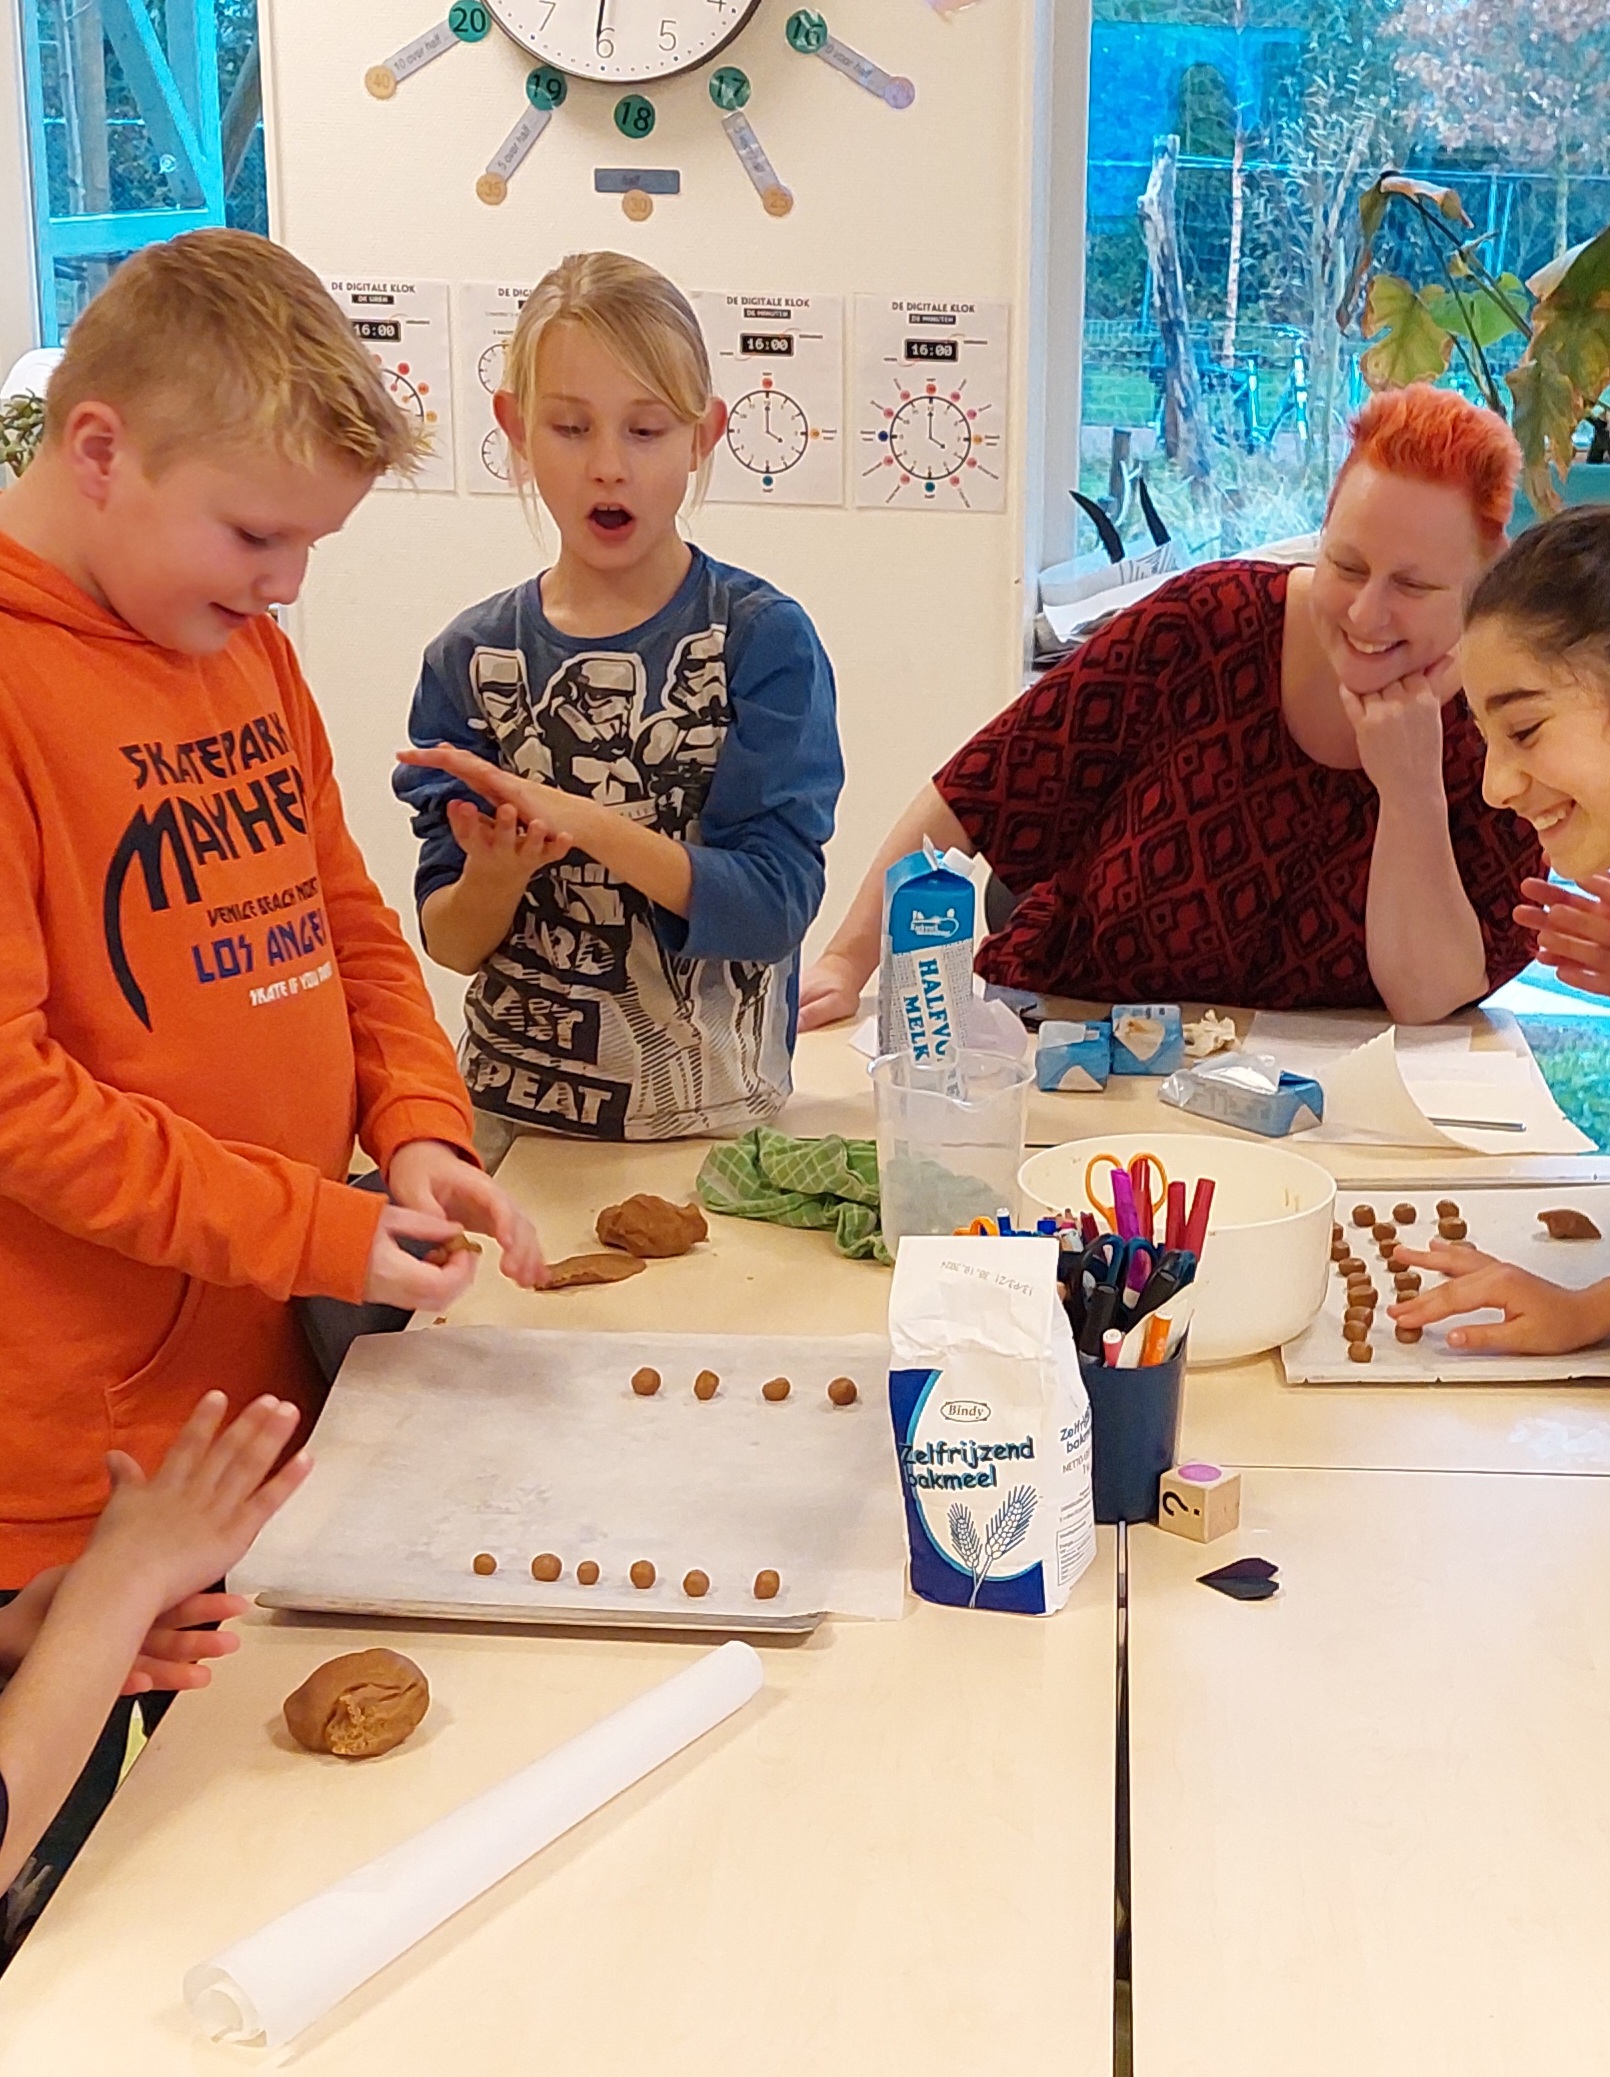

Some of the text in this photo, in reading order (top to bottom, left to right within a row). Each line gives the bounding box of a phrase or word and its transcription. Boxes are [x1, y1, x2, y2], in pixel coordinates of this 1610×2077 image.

[452, 8, 486, 33] 20
[539, 0, 556, 31] 7
[597, 27, 614, 58] 6
[659, 20, 676, 51] 5
[793, 16, 823, 47] 16
[406, 48, 425, 65] over
[425, 34, 442, 52] half
[532, 73, 562, 101] 19
[714, 75, 746, 98] 17
[621, 101, 651, 132] 18
[504, 143, 520, 163] over
[517, 123, 532, 145] half
[331, 282, 416, 294] DE DIGITALE KLOK
[498, 288, 509, 297] DE
[726, 296, 810, 308] DE DIGITALE KLOK
[891, 302, 975, 313] DE DIGITALE KLOK
[354, 323, 396, 338] 16:00
[747, 338, 789, 352] 16:00
[911, 343, 953, 357] 16:00
[119, 711, 291, 790] SKATEPARK
[207, 900, 258, 928] VENICE
[257, 887, 297, 916] BEACH
[191, 934, 254, 984] LOS
[249, 980, 288, 1006] SKATE
[903, 994, 931, 1062] MELK
[473, 1052, 613, 1126] PEAT
[948, 1404, 985, 1419] Bindy
[899, 1434, 1036, 1470] Zelfrijzend
[904, 1463, 998, 1491] bakmeel
[1162, 1491, 1201, 1517] ?
